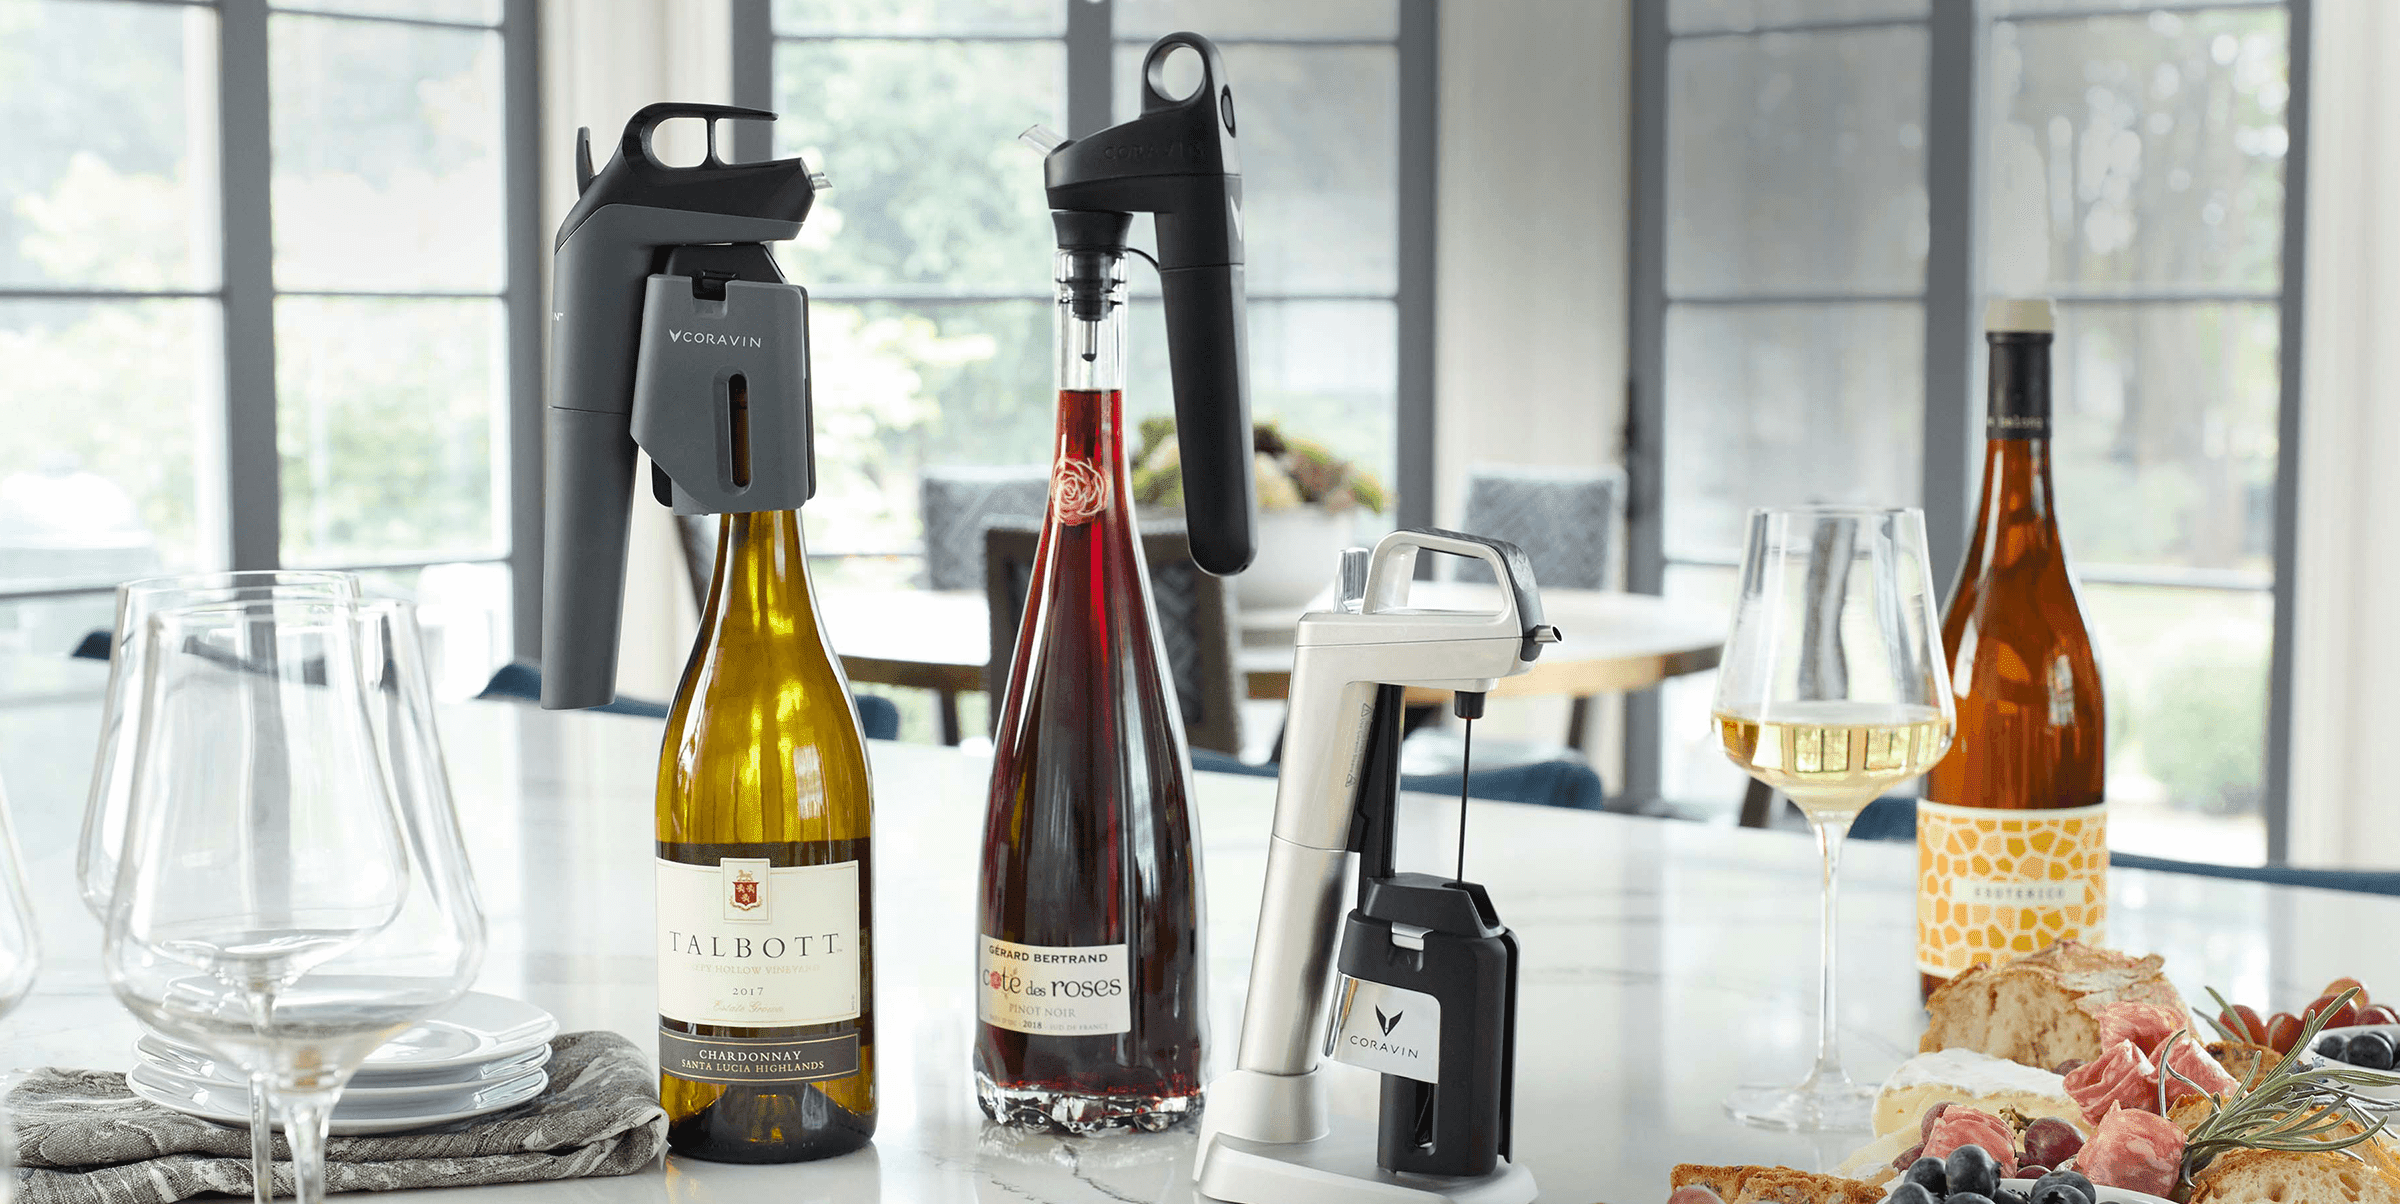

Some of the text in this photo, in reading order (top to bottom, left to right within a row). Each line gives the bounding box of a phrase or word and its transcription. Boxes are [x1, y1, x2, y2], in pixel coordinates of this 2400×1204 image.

[682, 331, 762, 349] CORAVIN
[988, 944, 1109, 965] GÉRARD BERTRAND
[732, 986, 765, 997] 2017
[1025, 980, 1047, 997] des
[1051, 978, 1123, 999] roses
[1008, 1003, 1077, 1018] PINOT NOIR
[1023, 1020, 1043, 1030] 2018
[1349, 1035, 1419, 1059] CORAVIN
[698, 1049, 802, 1062] CHARDONNAY
[681, 1058, 825, 1073] SANTA LUCIA HIGHLANDS
